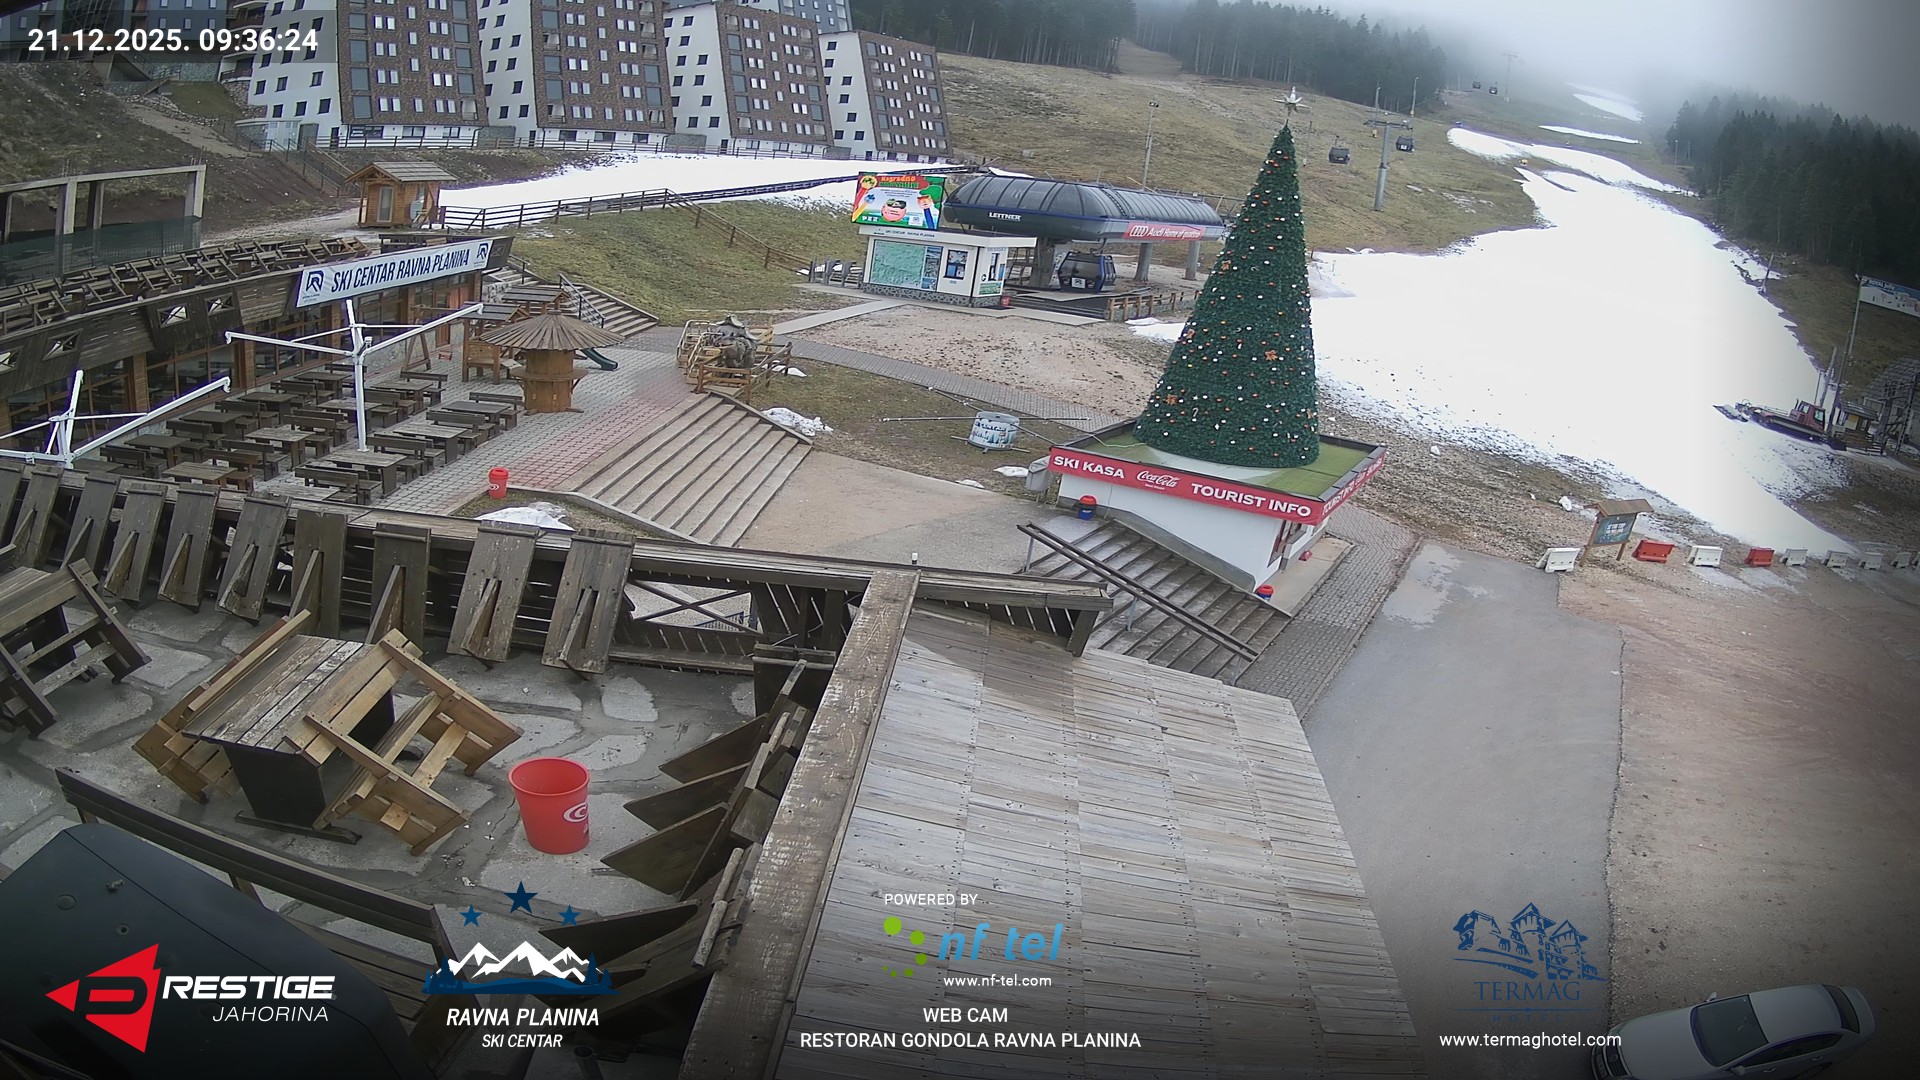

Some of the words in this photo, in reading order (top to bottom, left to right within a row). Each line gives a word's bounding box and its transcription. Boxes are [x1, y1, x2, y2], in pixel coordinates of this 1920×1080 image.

[989, 211, 1022, 222] LEITNER
[1146, 227, 1164, 237] Audi
[331, 270, 353, 293] SKI
[353, 261, 396, 289] CENTAR
[397, 255, 431, 280] RAVNA
[432, 249, 471, 273] PLANINA
[1053, 455, 1080, 470] SKI
[1082, 461, 1125, 479] KASA
[1191, 482, 1267, 507] TOURIST
[1268, 498, 1312, 518] INFO
